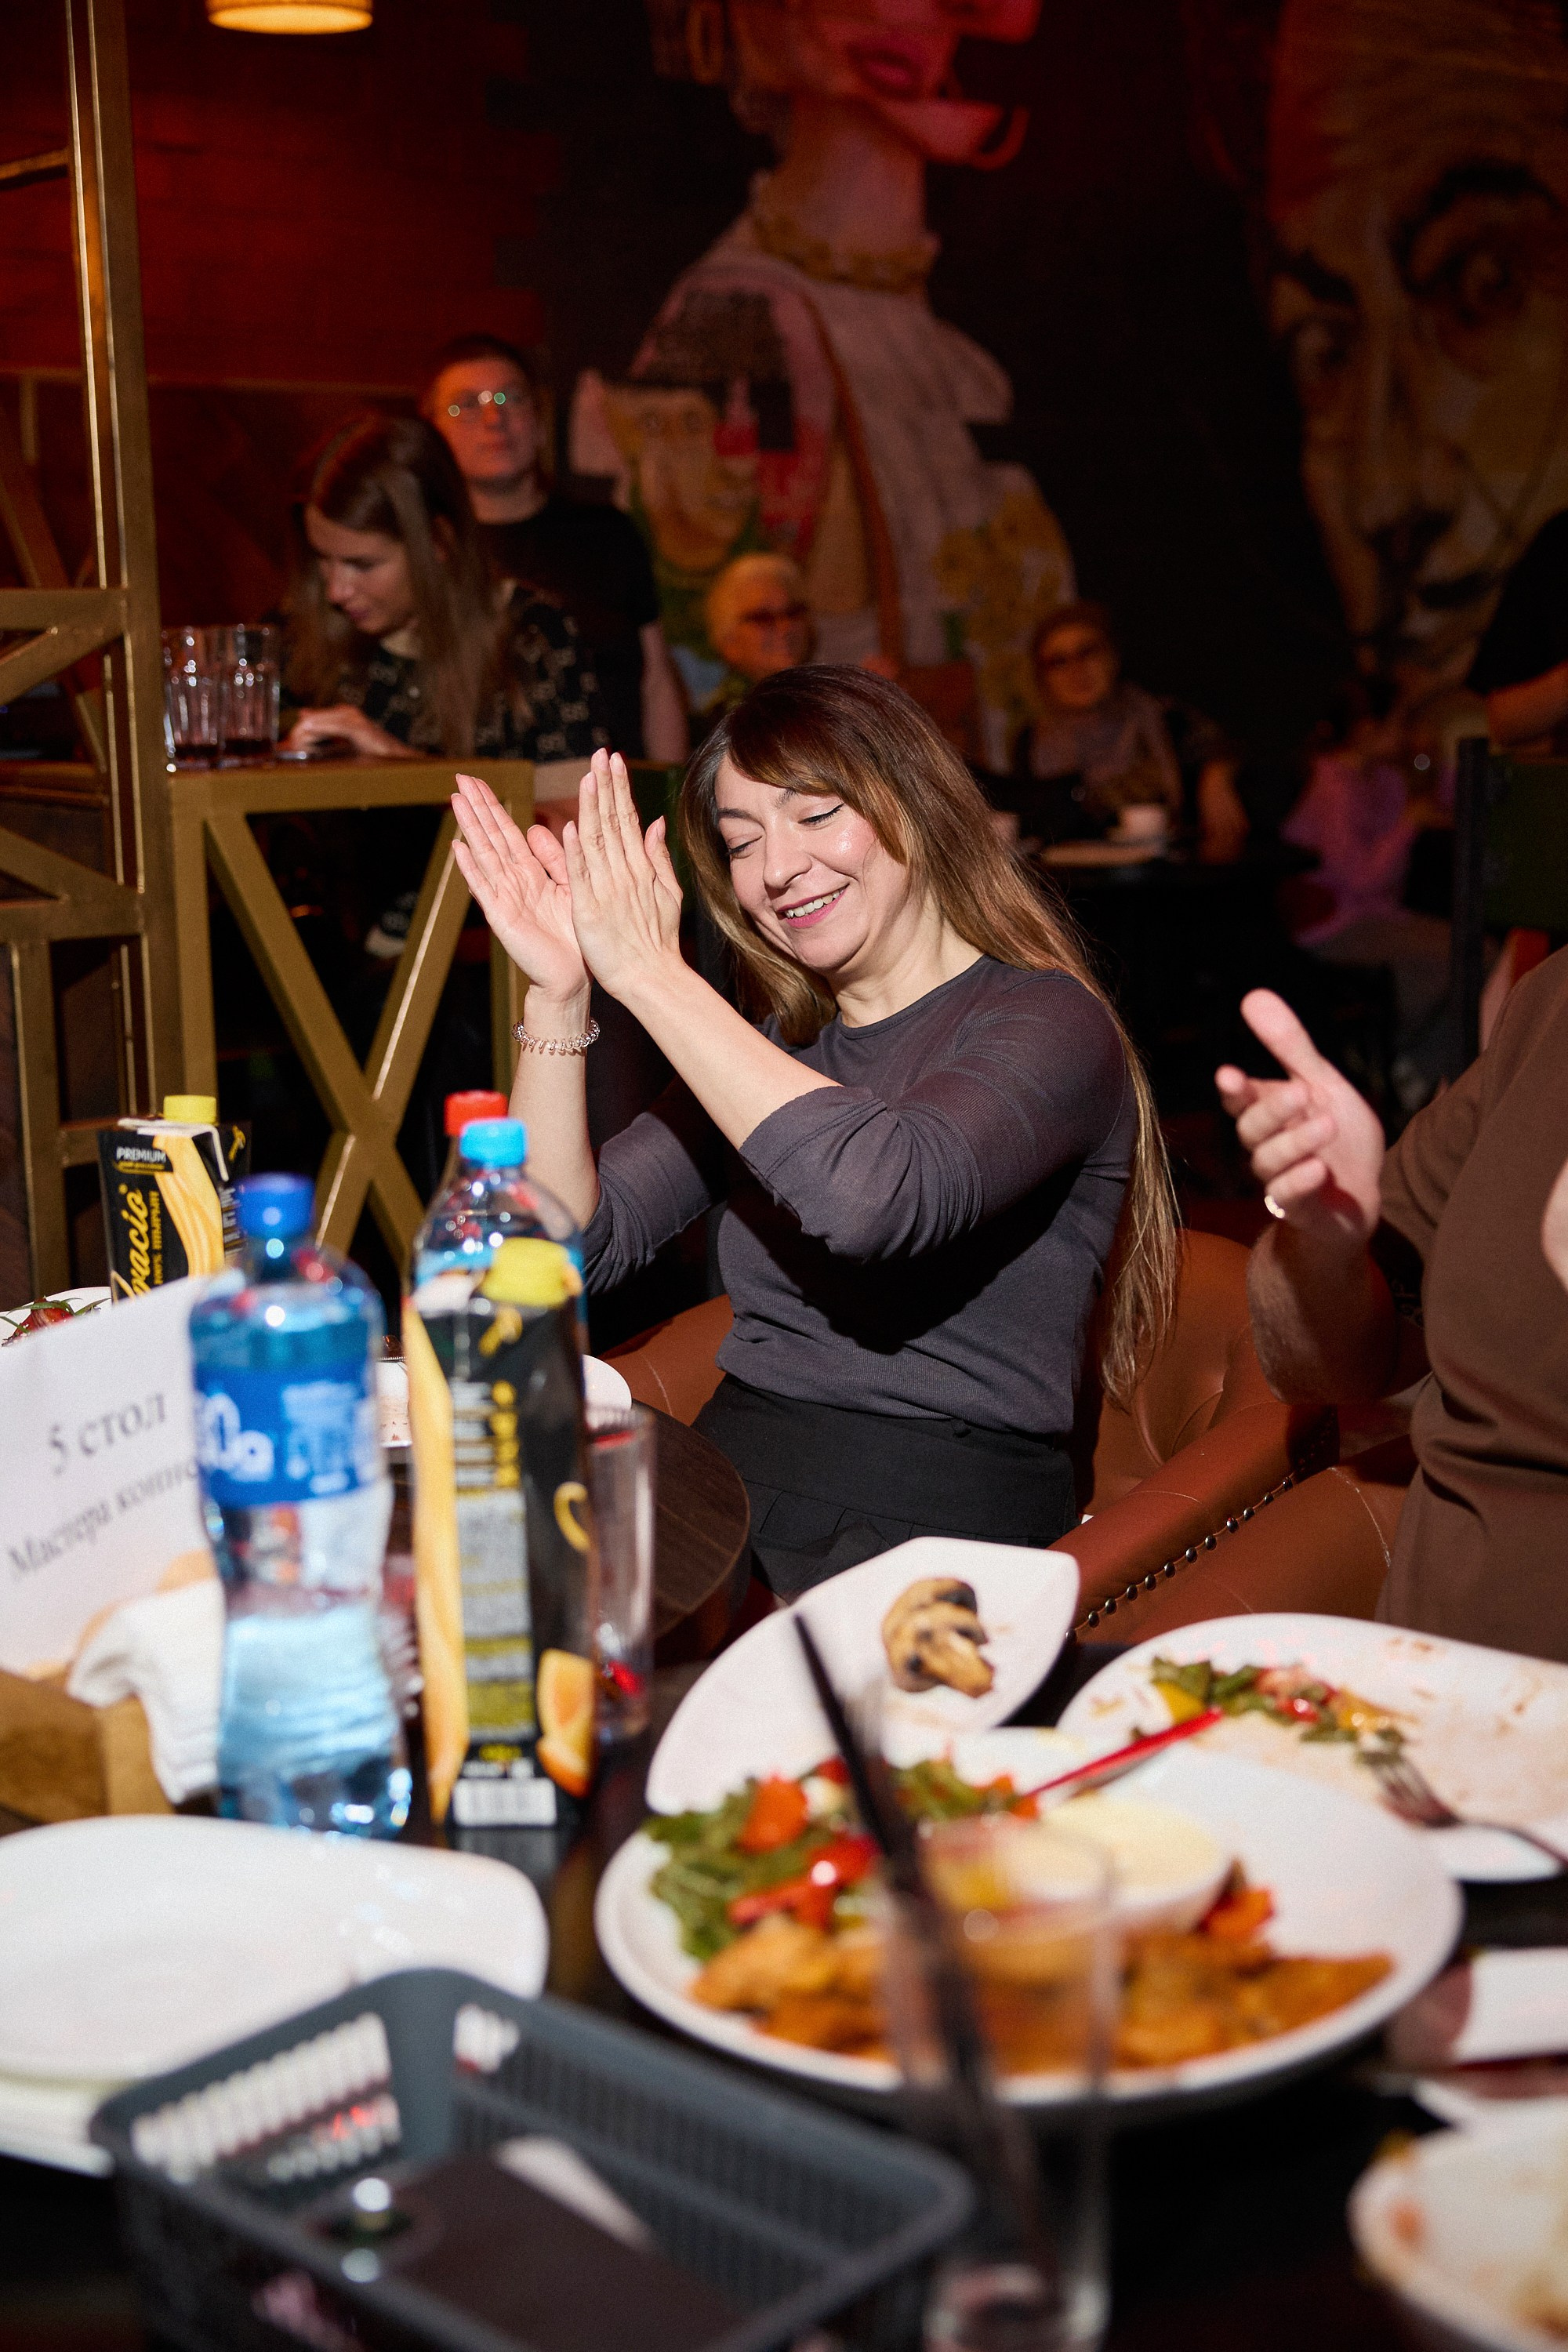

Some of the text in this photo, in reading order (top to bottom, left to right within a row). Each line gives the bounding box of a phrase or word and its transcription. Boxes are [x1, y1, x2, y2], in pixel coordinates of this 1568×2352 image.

[116, 1146, 167, 1163] PREMIUM
[49, 1421, 69, 1477] 5
[78, 1392, 166, 1457] стол
